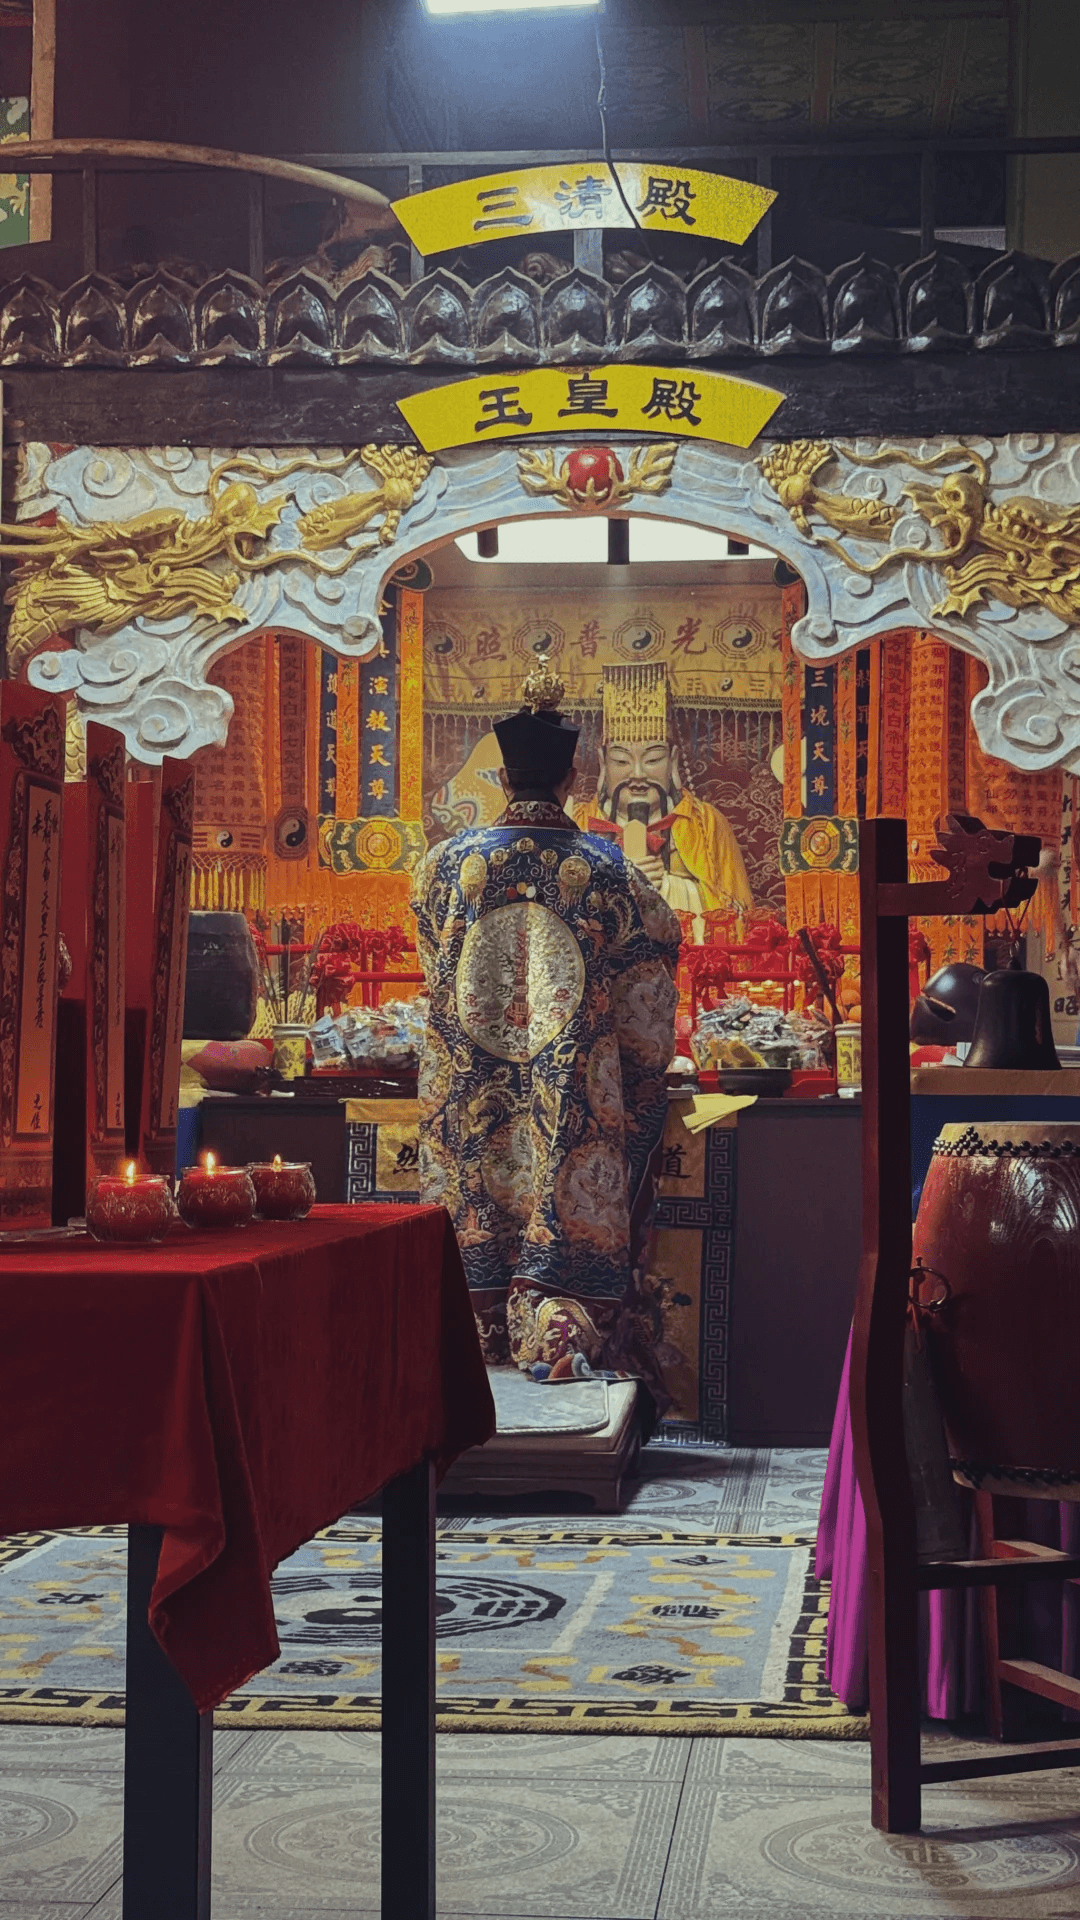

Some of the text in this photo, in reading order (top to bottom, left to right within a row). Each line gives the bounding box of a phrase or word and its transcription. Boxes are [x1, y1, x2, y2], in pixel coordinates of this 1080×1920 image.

[473, 175, 697, 232] 三清殿
[473, 372, 702, 433] 玉皇殿
[809, 669, 831, 797] 三境天尊
[662, 1143, 691, 1179] 道
